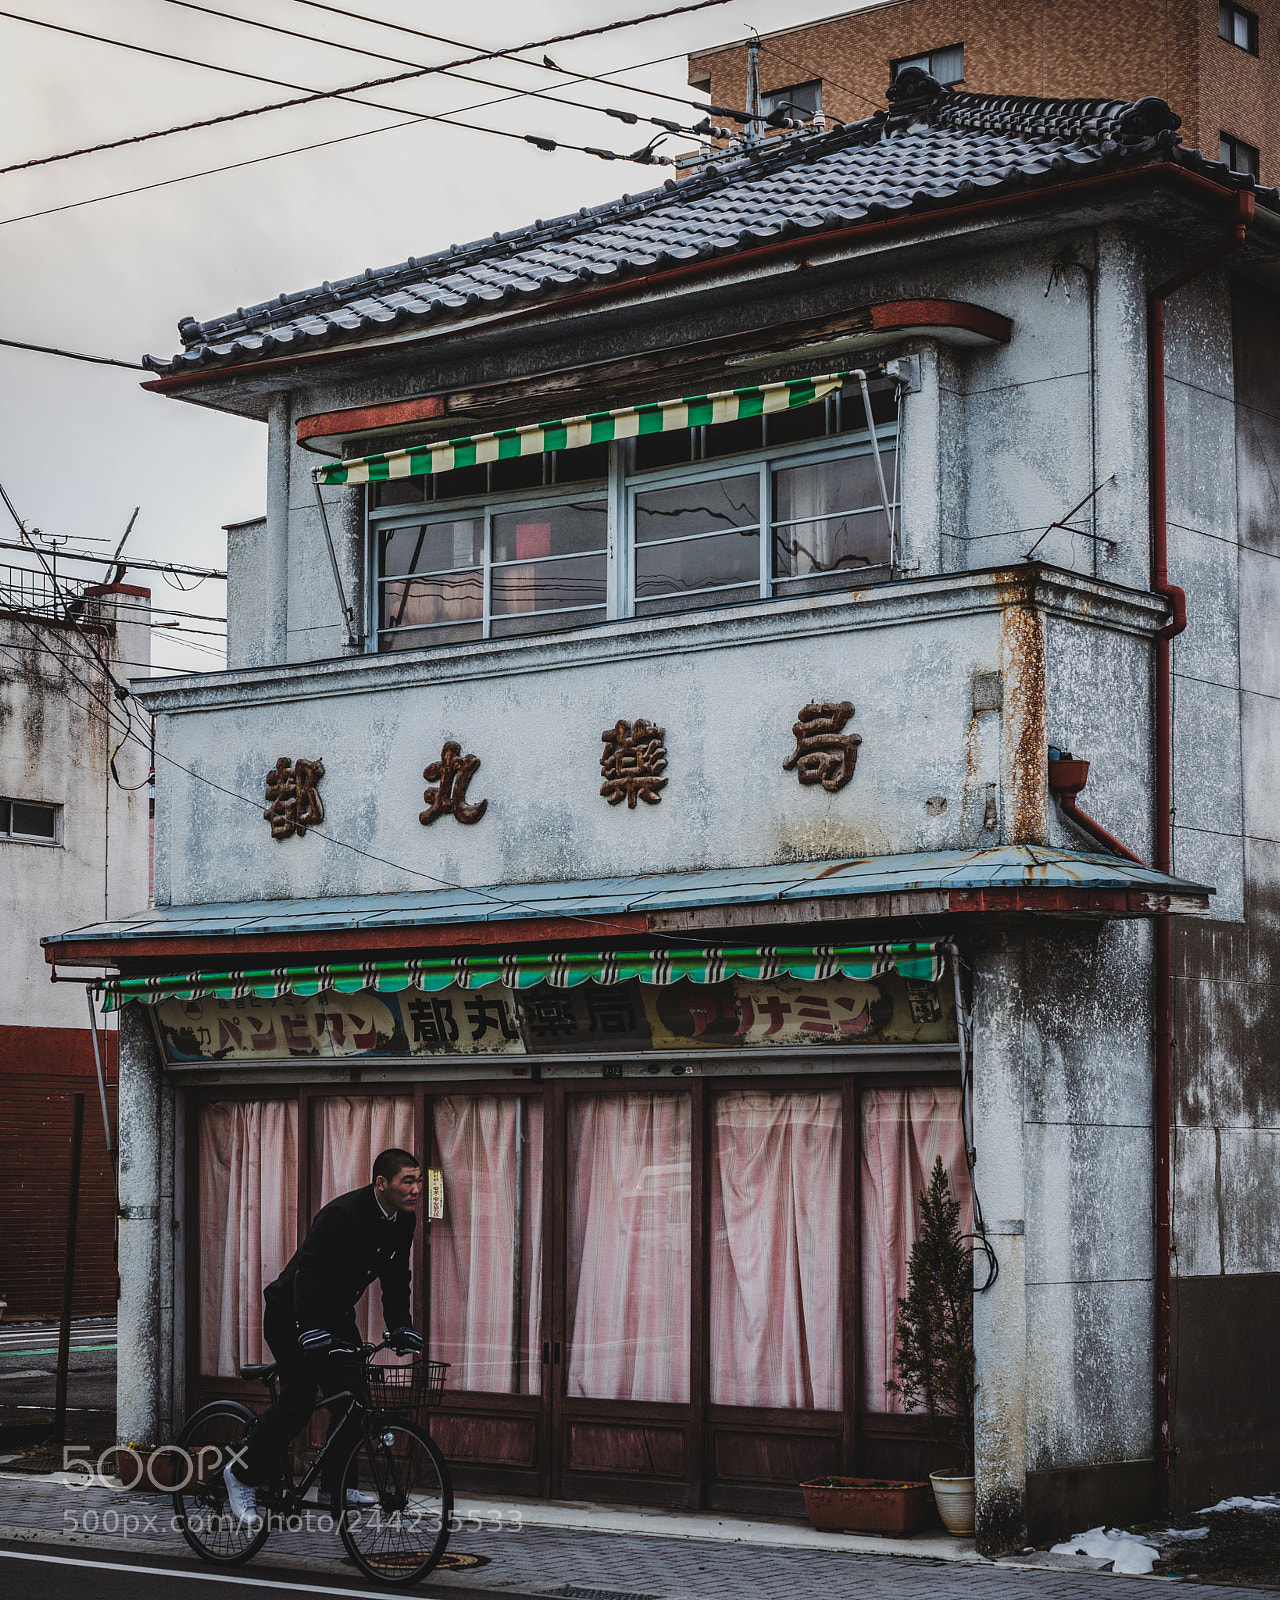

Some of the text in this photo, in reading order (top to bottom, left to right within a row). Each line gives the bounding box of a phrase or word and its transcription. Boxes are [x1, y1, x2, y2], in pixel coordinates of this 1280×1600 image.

[218, 1012, 378, 1051] パンビタン
[680, 994, 869, 1037] アリナミン
